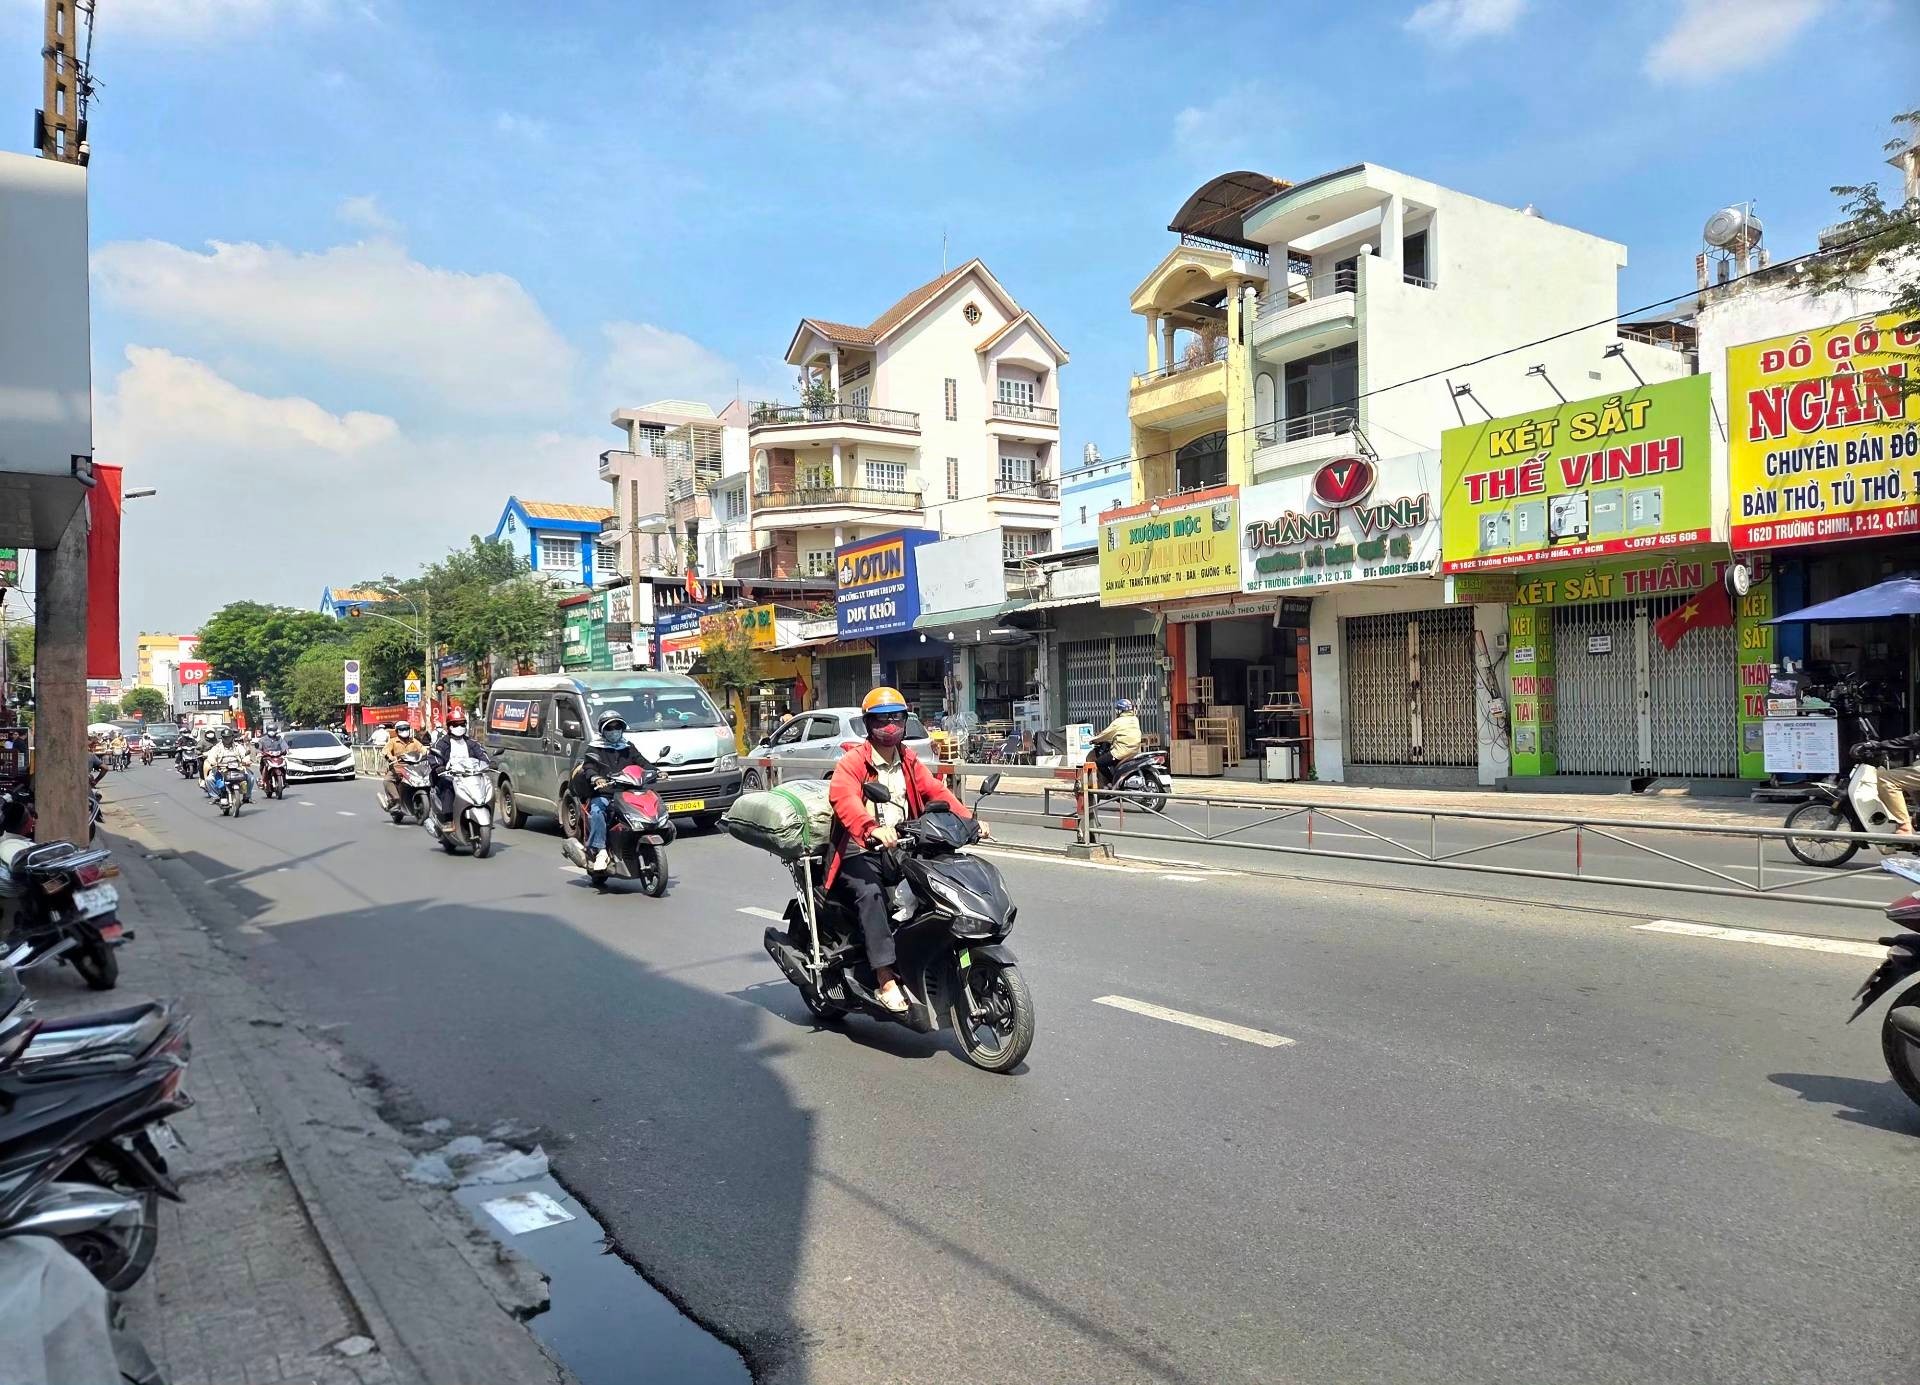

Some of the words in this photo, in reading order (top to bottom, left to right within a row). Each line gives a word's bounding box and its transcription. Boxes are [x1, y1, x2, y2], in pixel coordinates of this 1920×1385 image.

[1760, 336, 1812, 373] ĐỒ
[1827, 321, 1879, 359] GỖ
[1749, 361, 1907, 439] NGÂN
[1490, 417, 1558, 457] KÉT
[1570, 396, 1651, 441] SẮT
[1766, 440, 1838, 476] CHUYÊN
[1846, 433, 1883, 465] BÁN
[1464, 451, 1551, 504] THẾ
[1560, 436, 1683, 487] VINH
[1743, 487, 1777, 516] BÀN
[1784, 480, 1825, 512] THỜ,
[1831, 473, 1855, 505] TỦ
[1862, 468, 1907, 502] THỜ,
[1748, 528, 1772, 542] 162D
[1775, 521, 1815, 539] TRƯỜNG
[1818, 517, 1853, 535] CHINH,
[1856, 514, 1884, 531] P.12,
[1886, 508, 1918, 529] Q.TÂN
[1634, 536, 1658, 548] 0797
[1659, 534, 1677, 544] 455
[854, 547, 901, 583] JOTUN
[1264, 576, 1291, 588] TRƯỜNG
[1379, 564, 1401, 576] 0908
[1514, 577, 1557, 606] KÉT
[1564, 568, 1614, 600] SẮT
[1623, 558, 1704, 595] THẦN
[847, 605, 868, 624] DUY
[870, 597, 896, 620] KHÔI
[1238, 606, 1255, 615] THEO
[1743, 592, 1767, 617] KÉT
[1512, 614, 1531, 636] KÉT
[1743, 619, 1768, 649] SẮT
[1512, 672, 1536, 695] THẦN
[1515, 698, 1535, 722] TÀI
[1744, 691, 1767, 717] TÀ
